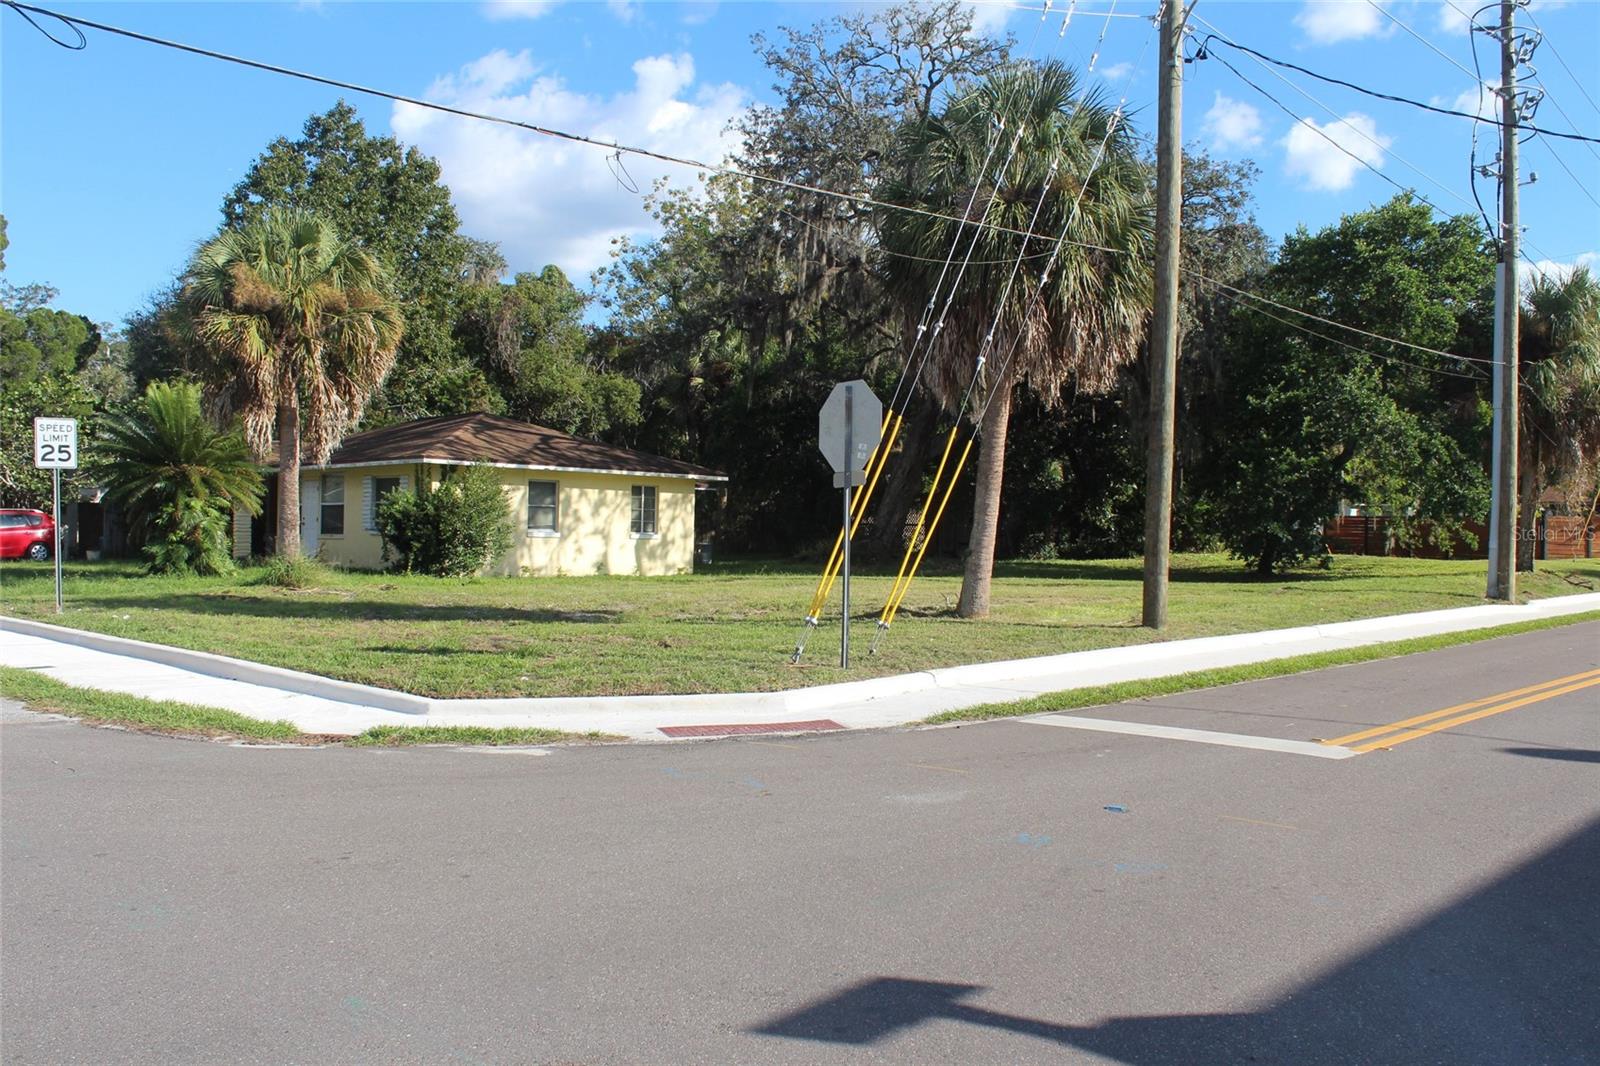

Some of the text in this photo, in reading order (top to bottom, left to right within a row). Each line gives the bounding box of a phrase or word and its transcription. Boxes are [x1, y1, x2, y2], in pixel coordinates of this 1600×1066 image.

[39, 424, 73, 432] SPEED
[42, 434, 69, 442] LIMIT
[41, 444, 72, 462] 25
